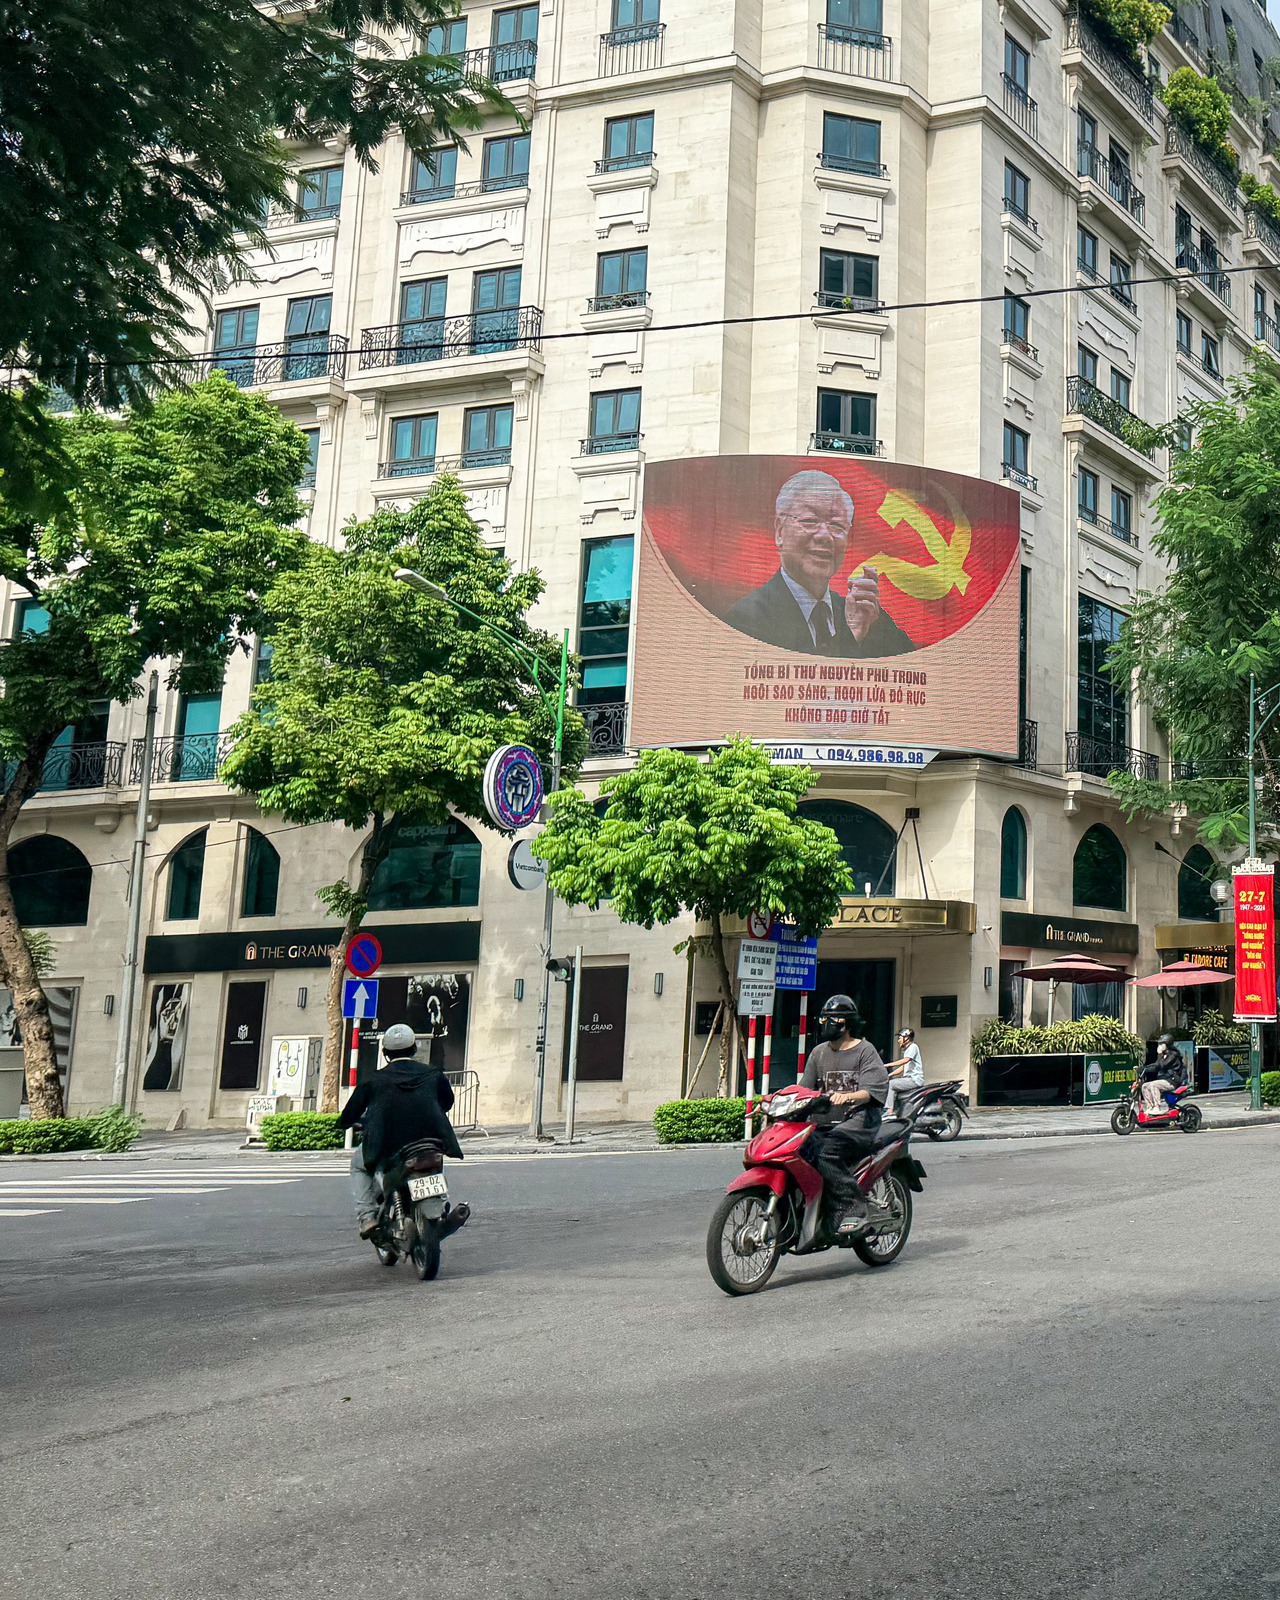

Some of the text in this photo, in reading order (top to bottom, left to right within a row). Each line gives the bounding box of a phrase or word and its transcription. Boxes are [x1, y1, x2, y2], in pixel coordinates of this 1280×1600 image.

[744, 661, 774, 680] TỔNG
[778, 663, 790, 680] BÍ
[794, 664, 818, 680] THƯ
[867, 666, 889, 683] PHÚ
[892, 669, 927, 687] TRỌNG
[743, 683, 769, 700] NGÔI
[773, 685, 794, 700] SAO
[834, 685, 864, 704] NGỌN
[867, 684, 886, 703] LỬA
[906, 690, 926, 708] RỰC
[785, 705, 822, 723] KHÔNG
[826, 708, 847, 723] BAO
[851, 706, 870, 724] GIỜ
[765, 747, 924, 764] MAN 094.986.98.98
[515, 863, 545, 873] Vietcombank
[1239, 891, 1266, 903] 27-7
[839, 907, 903, 923] LACE
[1067, 931, 1090, 943] GRAND
[260, 946, 285, 959] THE
[591, 1023, 613, 1031] GRAND
